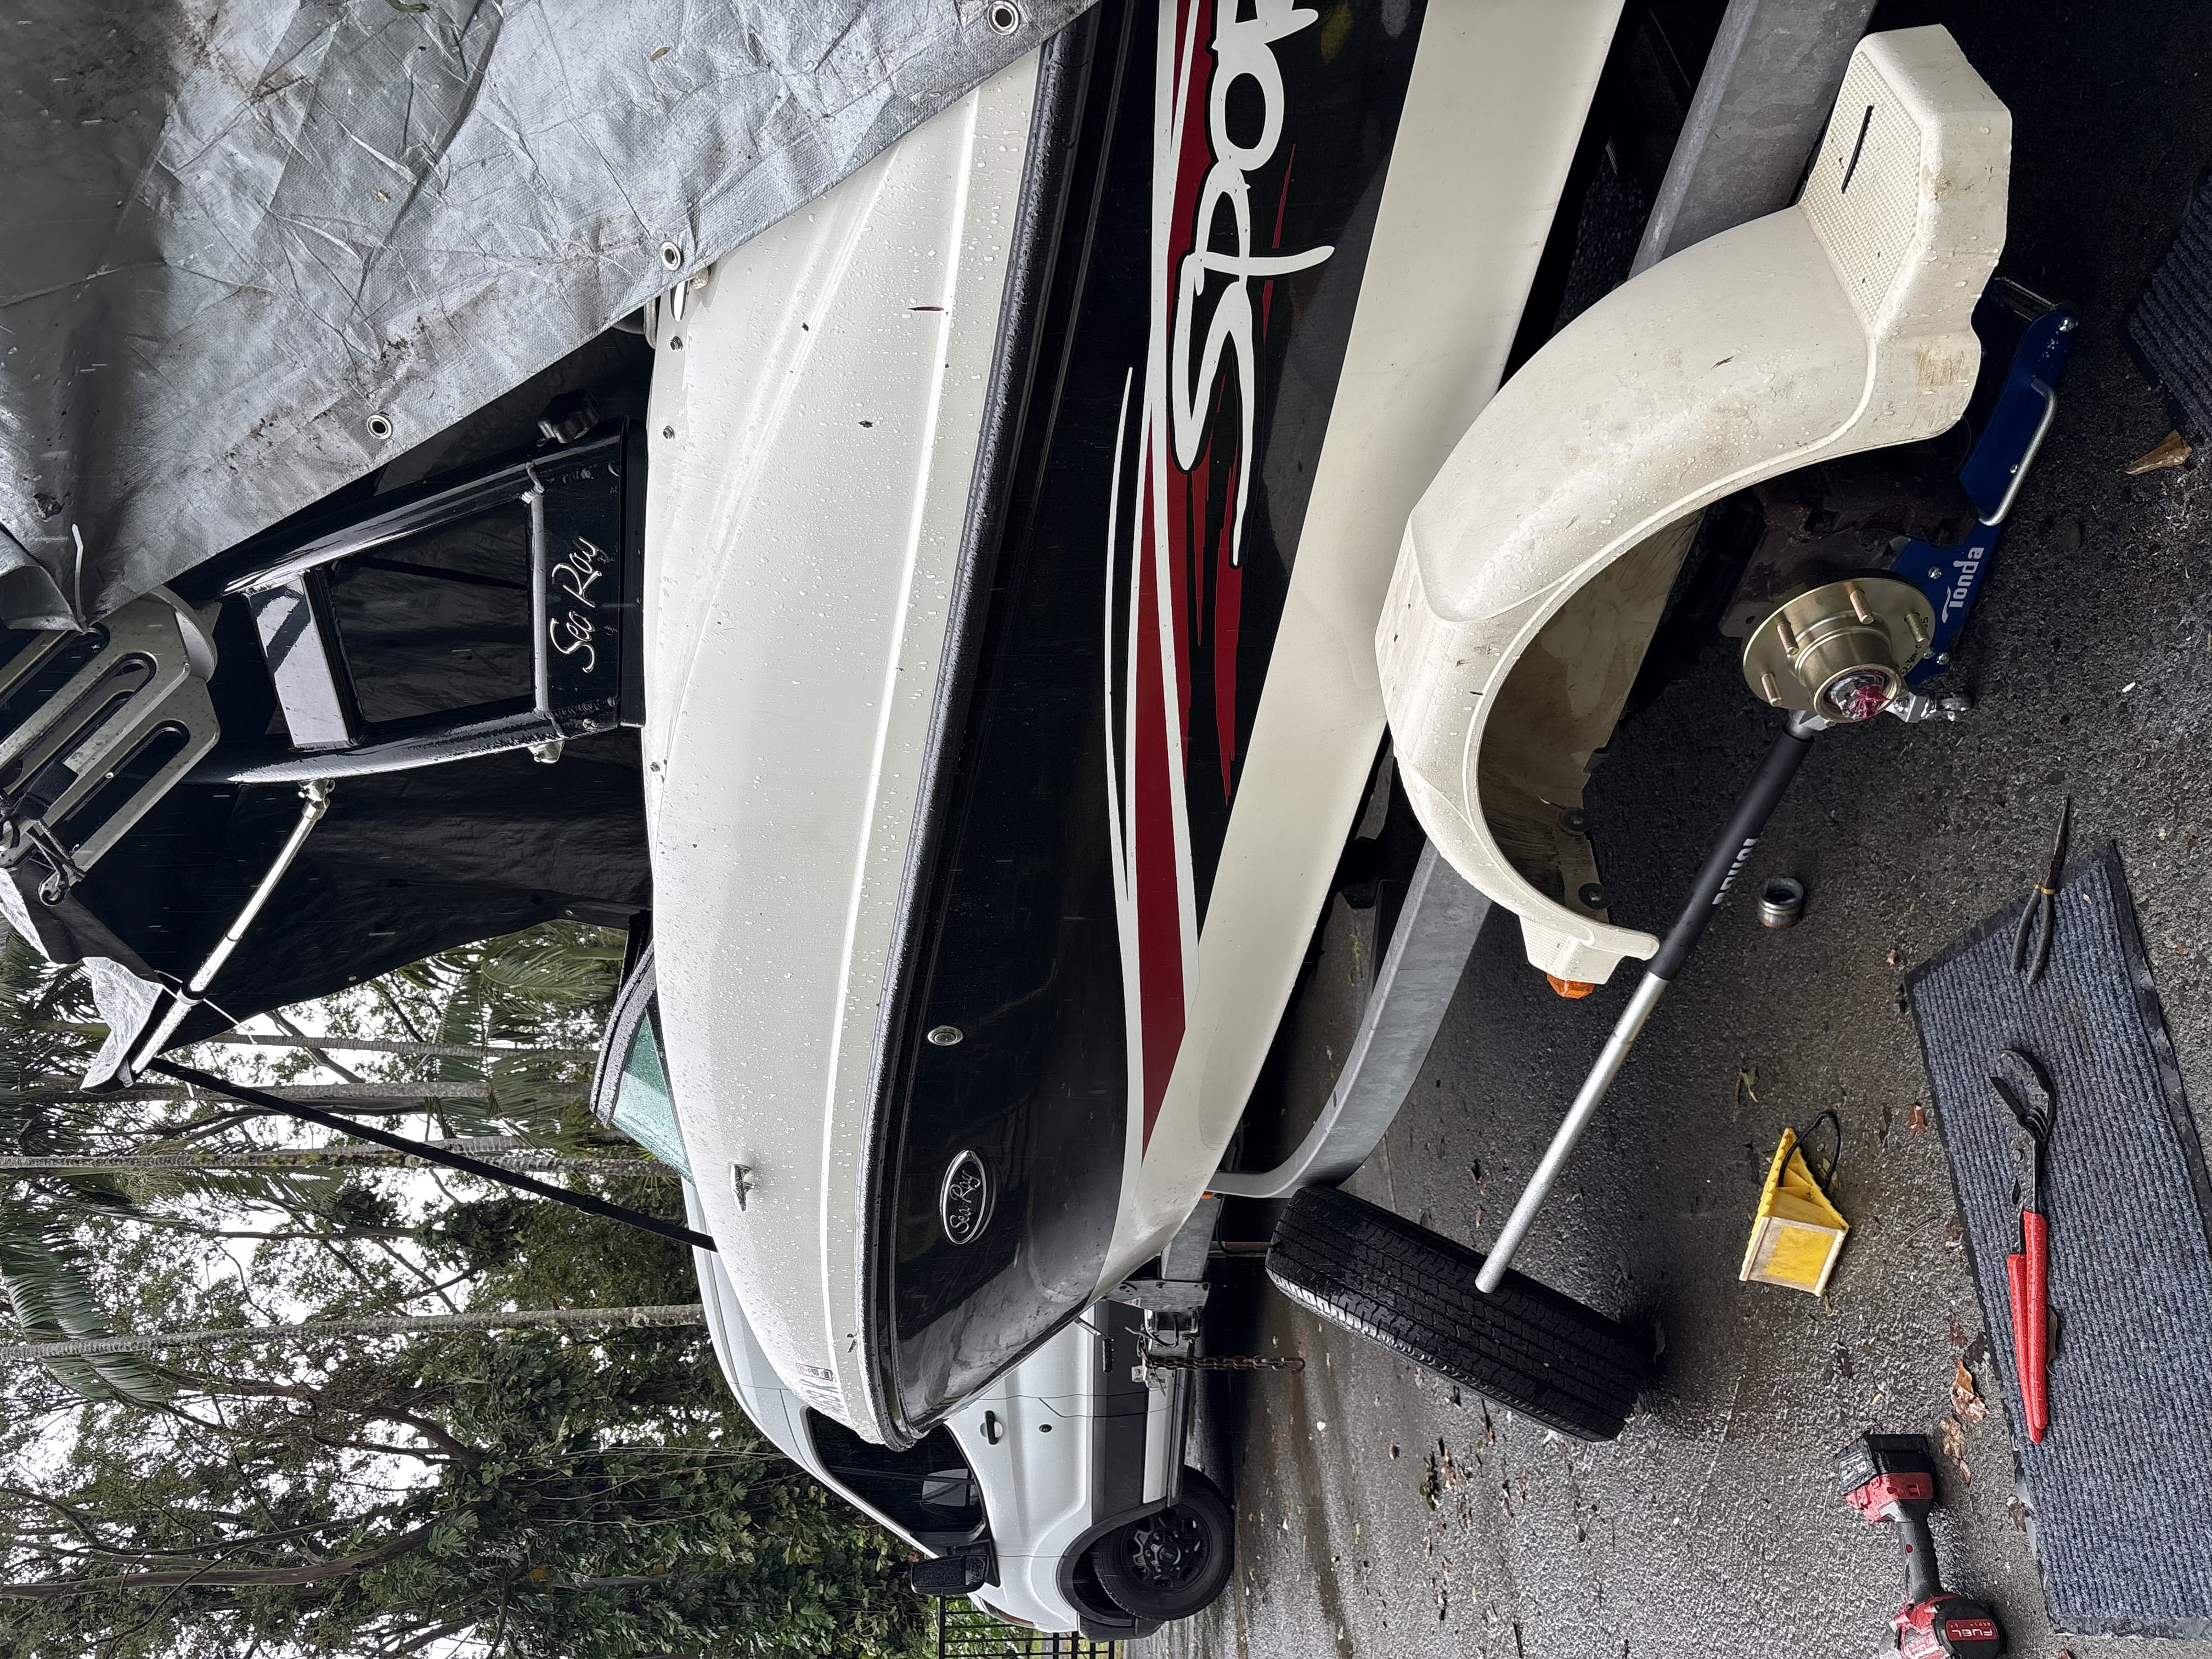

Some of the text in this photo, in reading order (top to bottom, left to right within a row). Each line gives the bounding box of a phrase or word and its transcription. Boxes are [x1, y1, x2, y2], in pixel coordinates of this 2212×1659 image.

[550, 535, 610, 674] Sea Ray
[1941, 546, 1985, 624] Tonda
[949, 1170, 981, 1234] Sea Ray
[1951, 1628, 1993, 1637] FUEL
